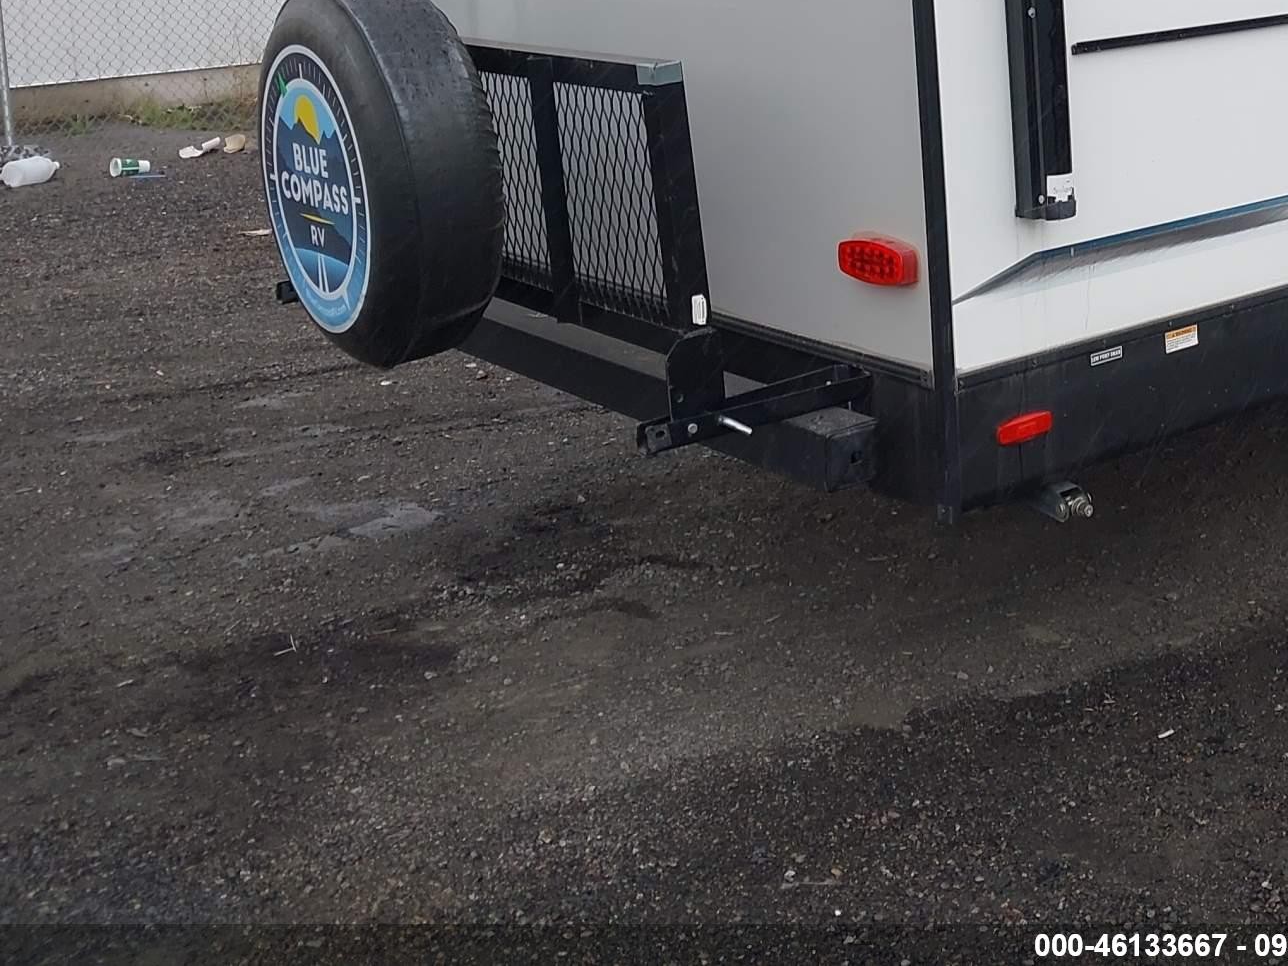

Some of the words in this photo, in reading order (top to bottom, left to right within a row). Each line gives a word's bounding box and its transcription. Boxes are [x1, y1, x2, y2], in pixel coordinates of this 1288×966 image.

[293, 142, 328, 178] BLUE
[281, 170, 349, 215] COMPASS
[310, 224, 325, 248] RV
